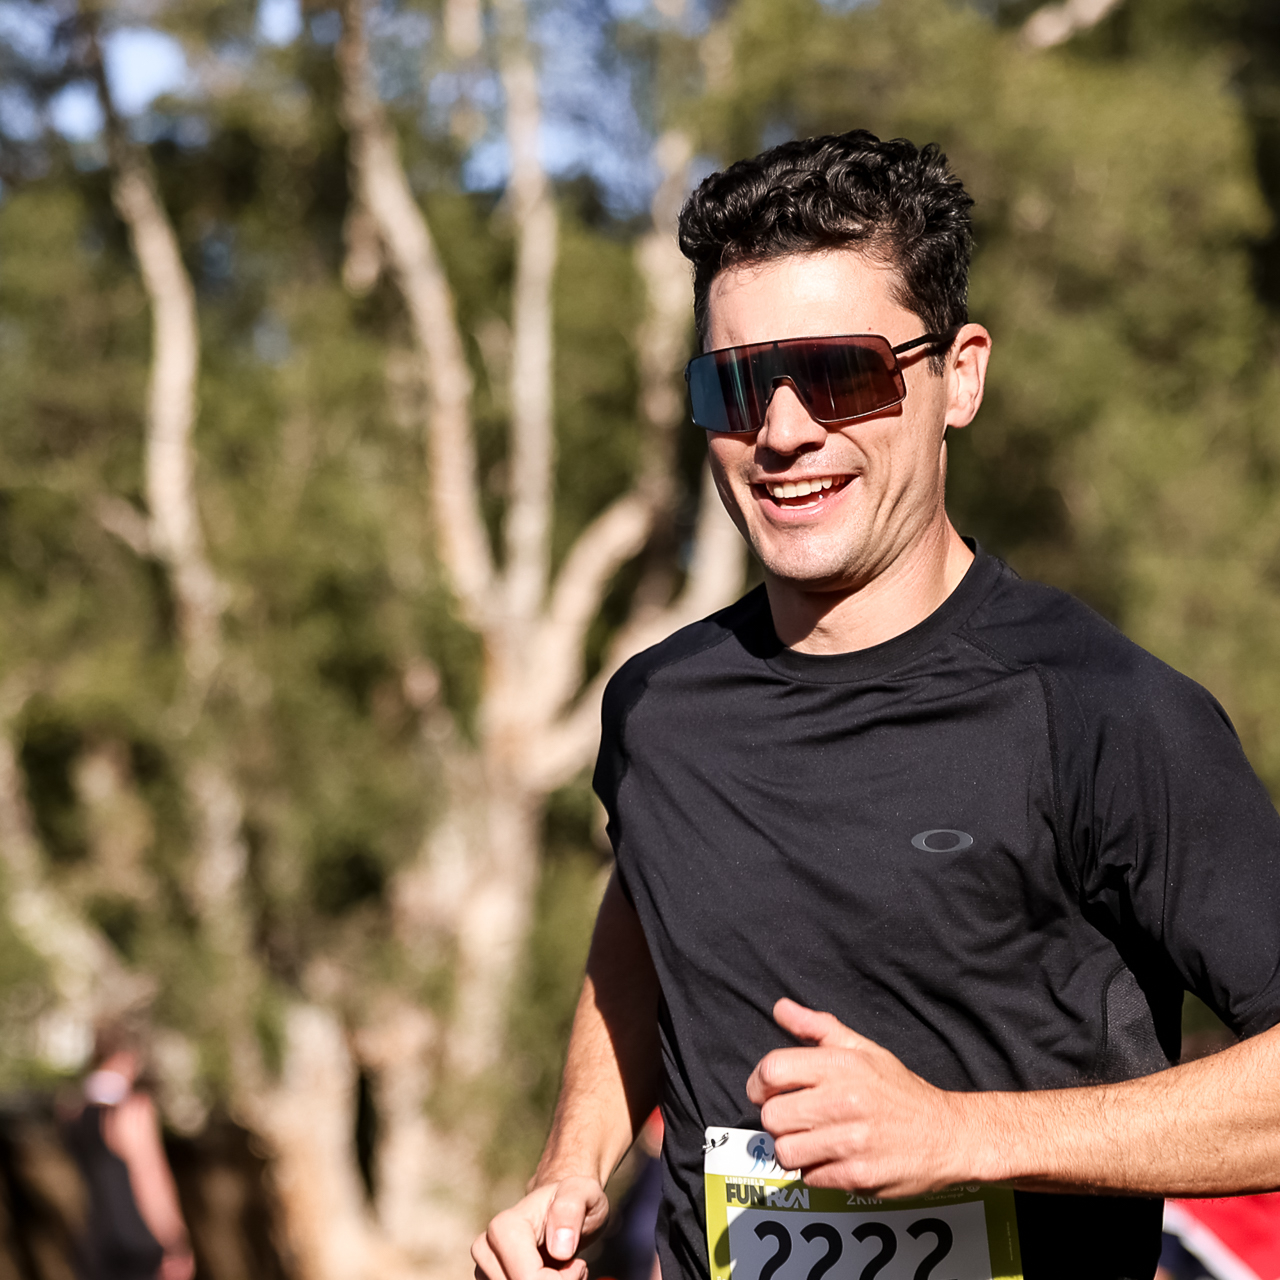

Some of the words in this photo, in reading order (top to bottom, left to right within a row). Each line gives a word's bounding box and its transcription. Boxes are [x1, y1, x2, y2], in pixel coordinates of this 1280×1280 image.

[724, 1176, 765, 1186] LINDFIELD
[726, 1183, 765, 1206] FUN
[765, 1185, 810, 1209] RUN
